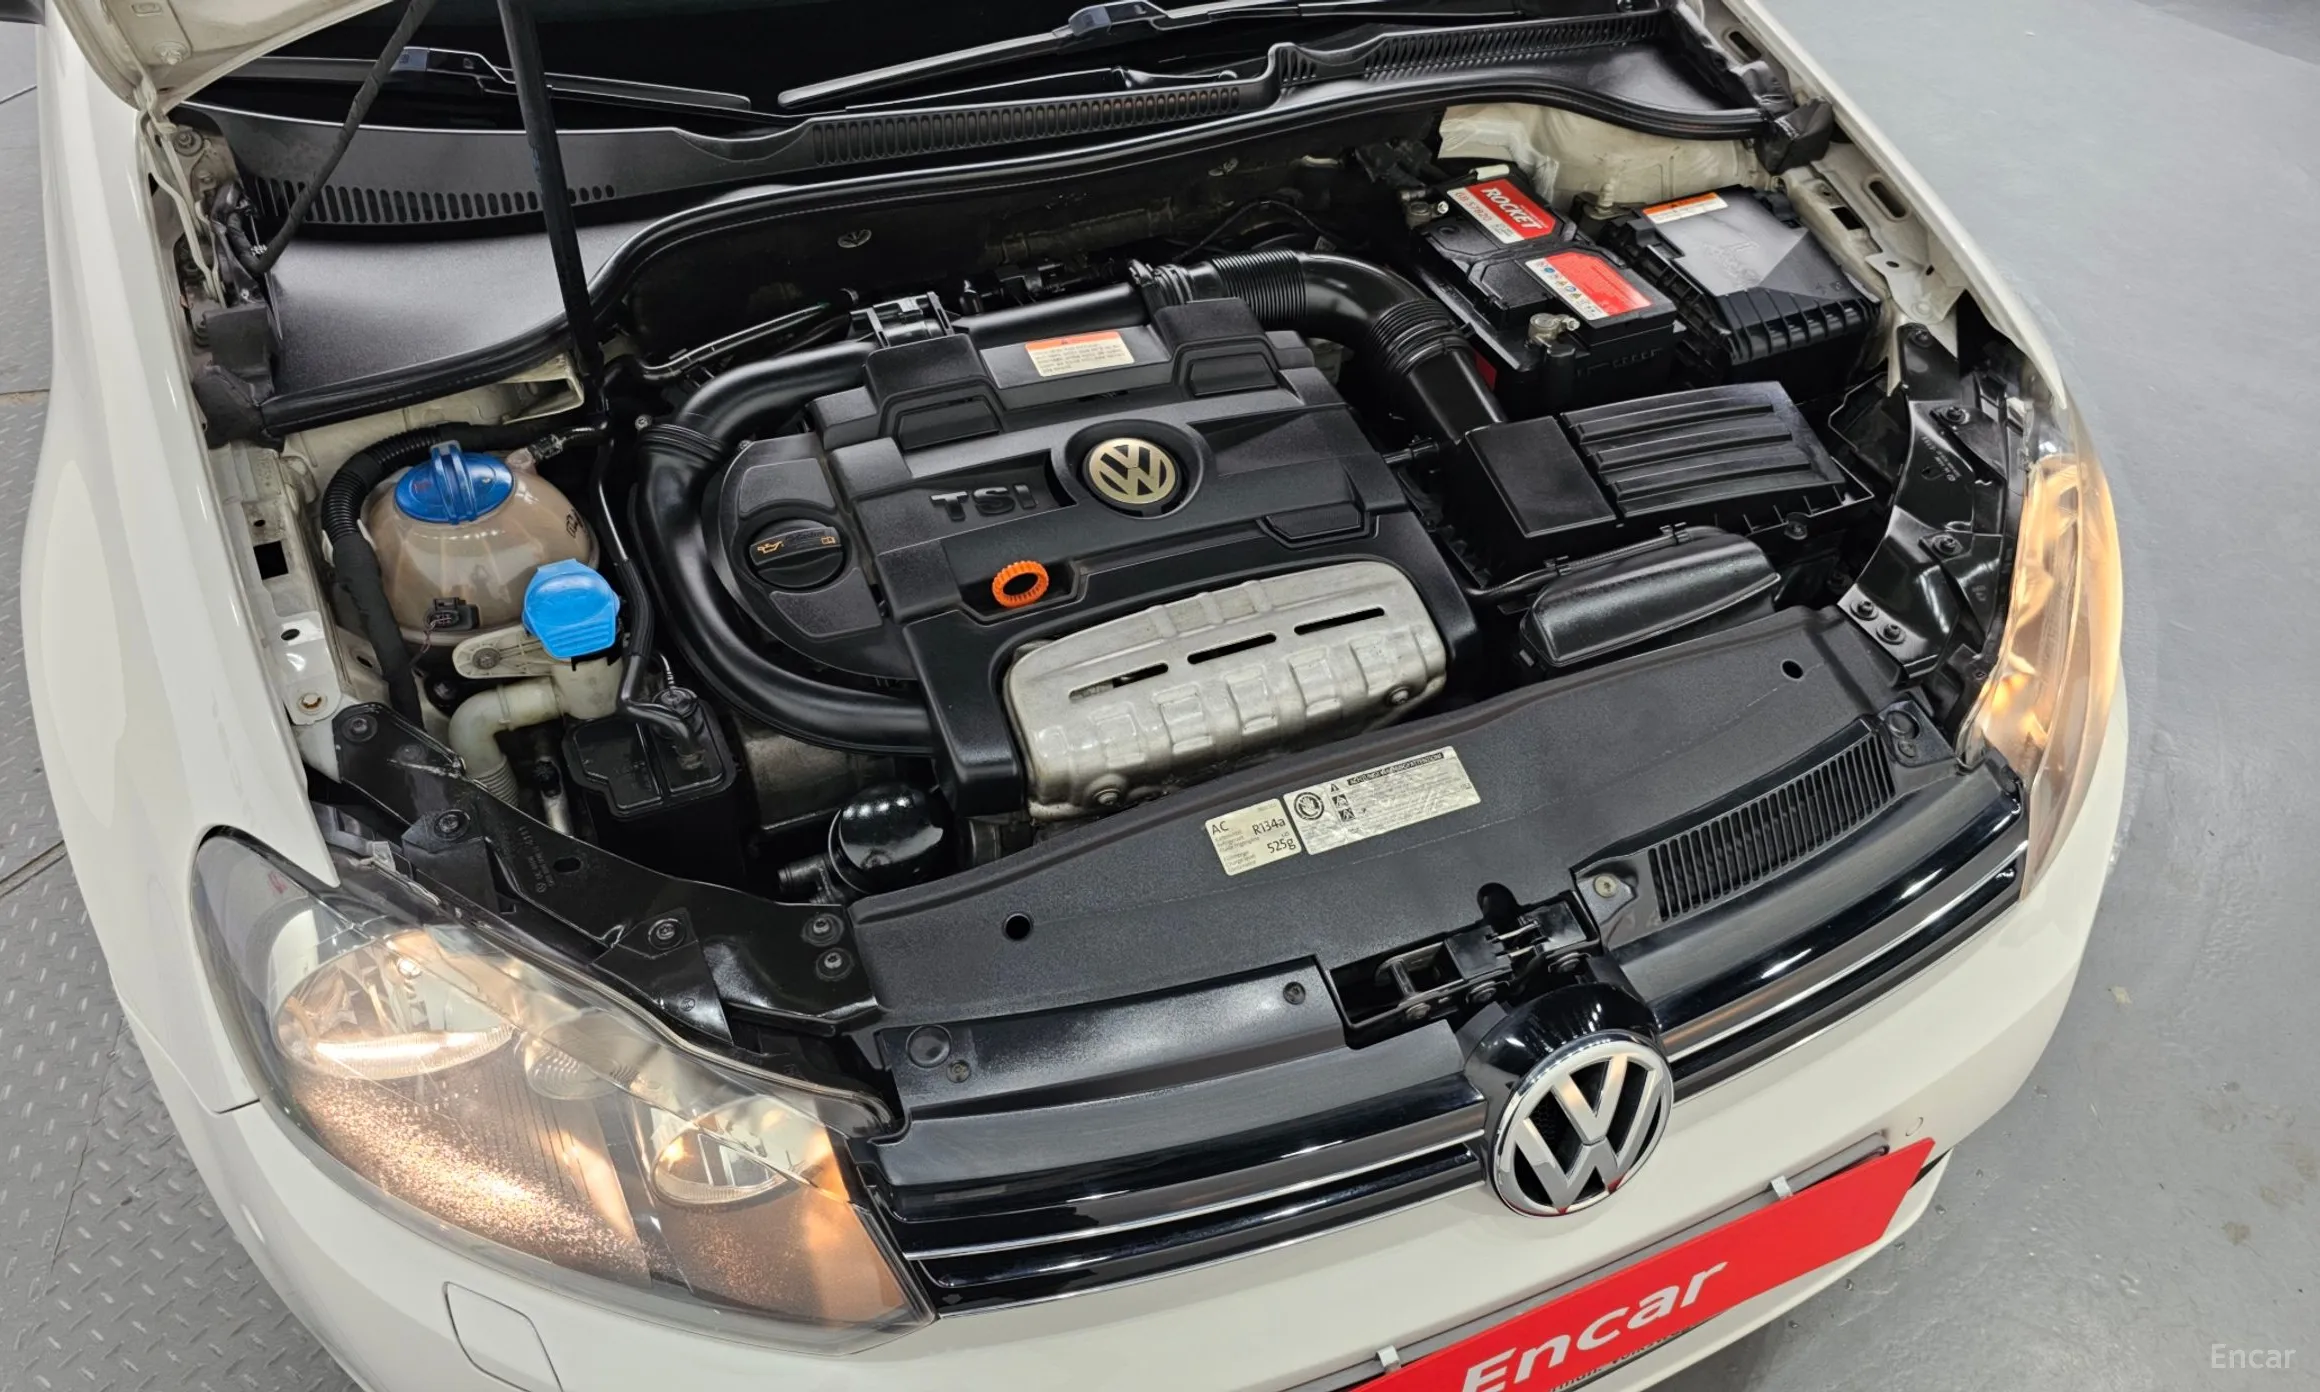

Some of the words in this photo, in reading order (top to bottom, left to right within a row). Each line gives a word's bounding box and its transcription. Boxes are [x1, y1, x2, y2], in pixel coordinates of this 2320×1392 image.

[1481, 187, 1543, 229] ROCKET
[931, 484, 1038, 521] TSI
[1212, 820, 1229, 836] AC
[1252, 818, 1286, 836] R134a
[1266, 838, 1297, 854] 525g
[1461, 1261, 1729, 1392] Encar
